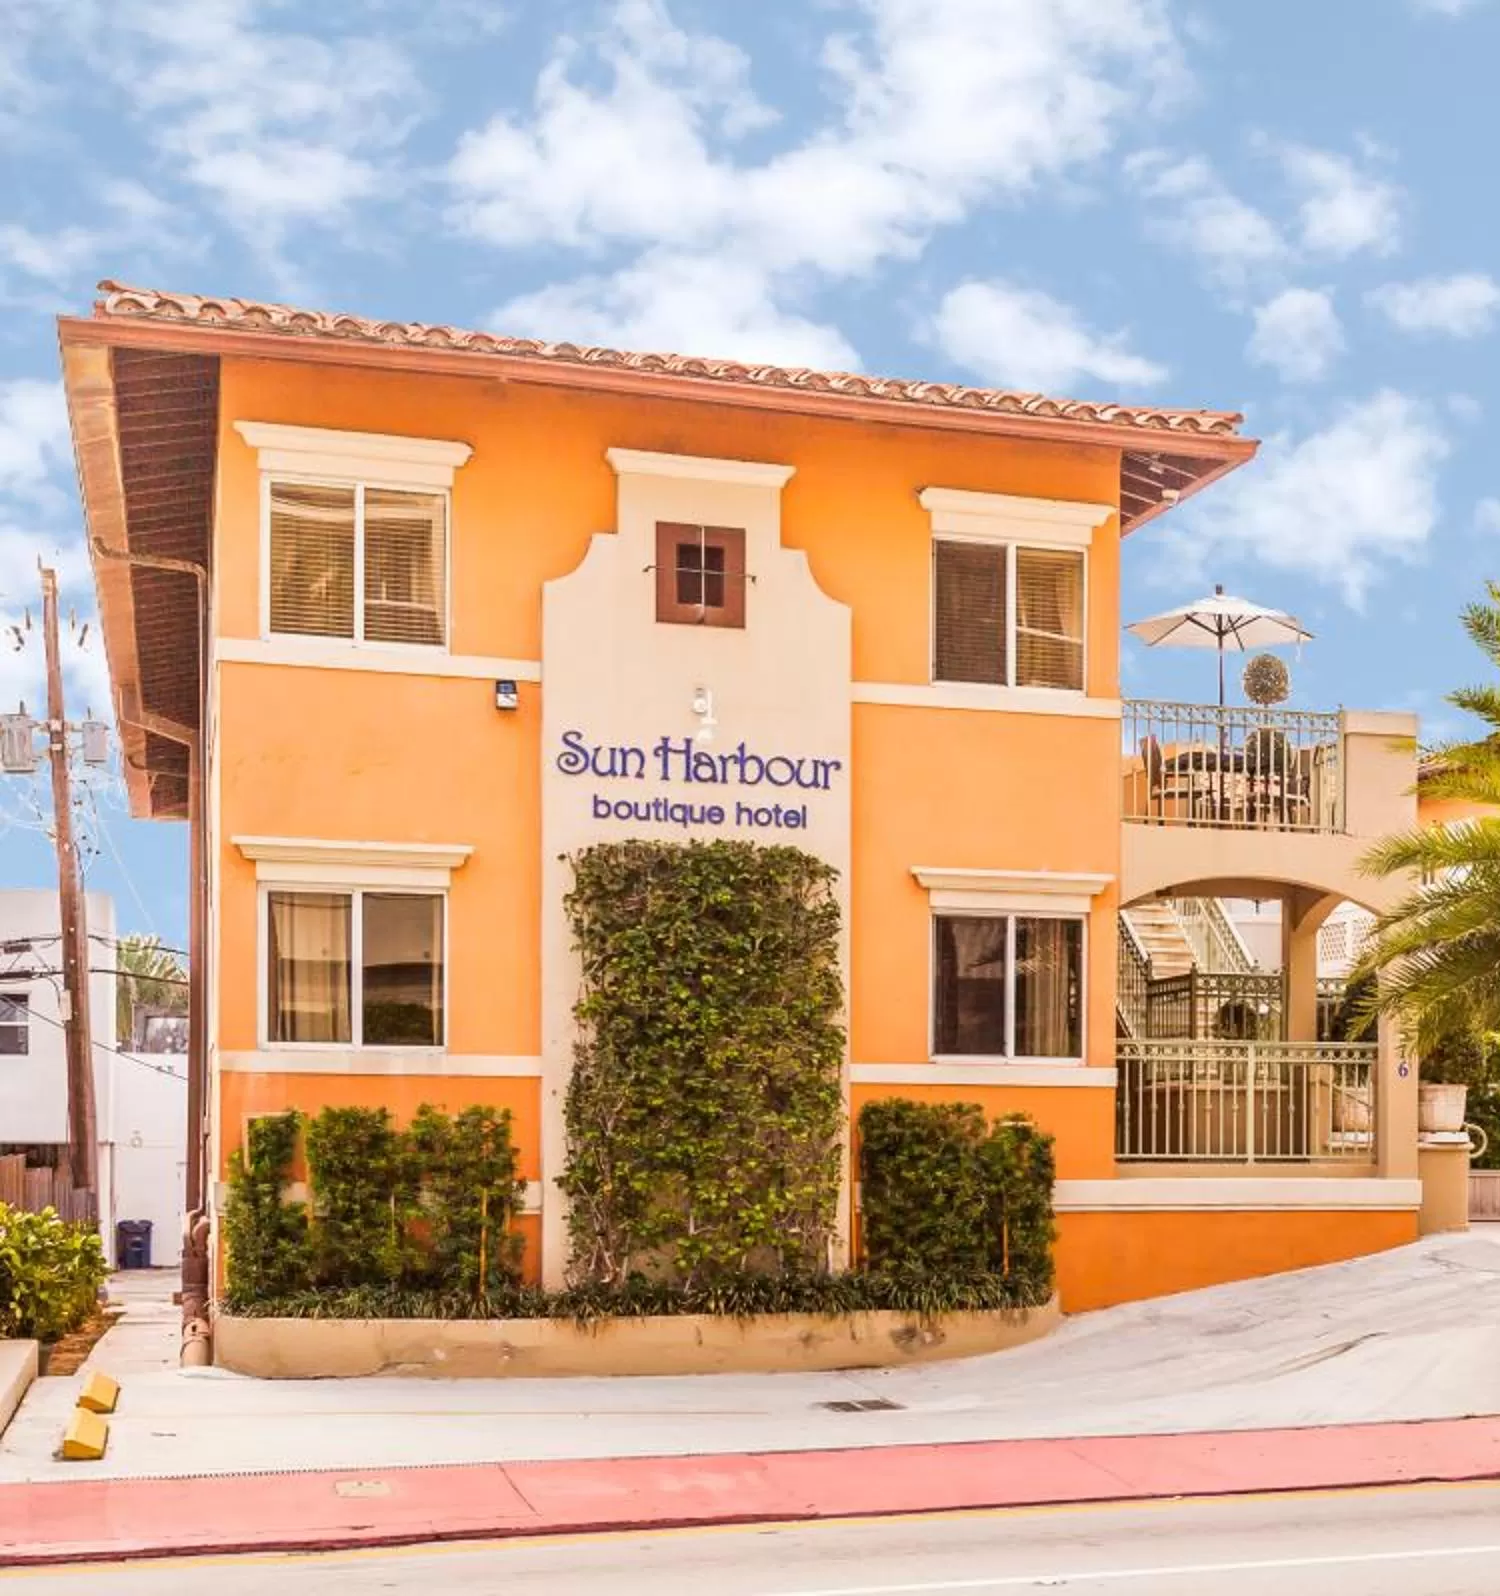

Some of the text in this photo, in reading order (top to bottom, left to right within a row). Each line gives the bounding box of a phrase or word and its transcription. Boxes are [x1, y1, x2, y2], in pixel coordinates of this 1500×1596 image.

[557, 730, 842, 790] Sun Harbour
[592, 794, 807, 829] boutique hotel
